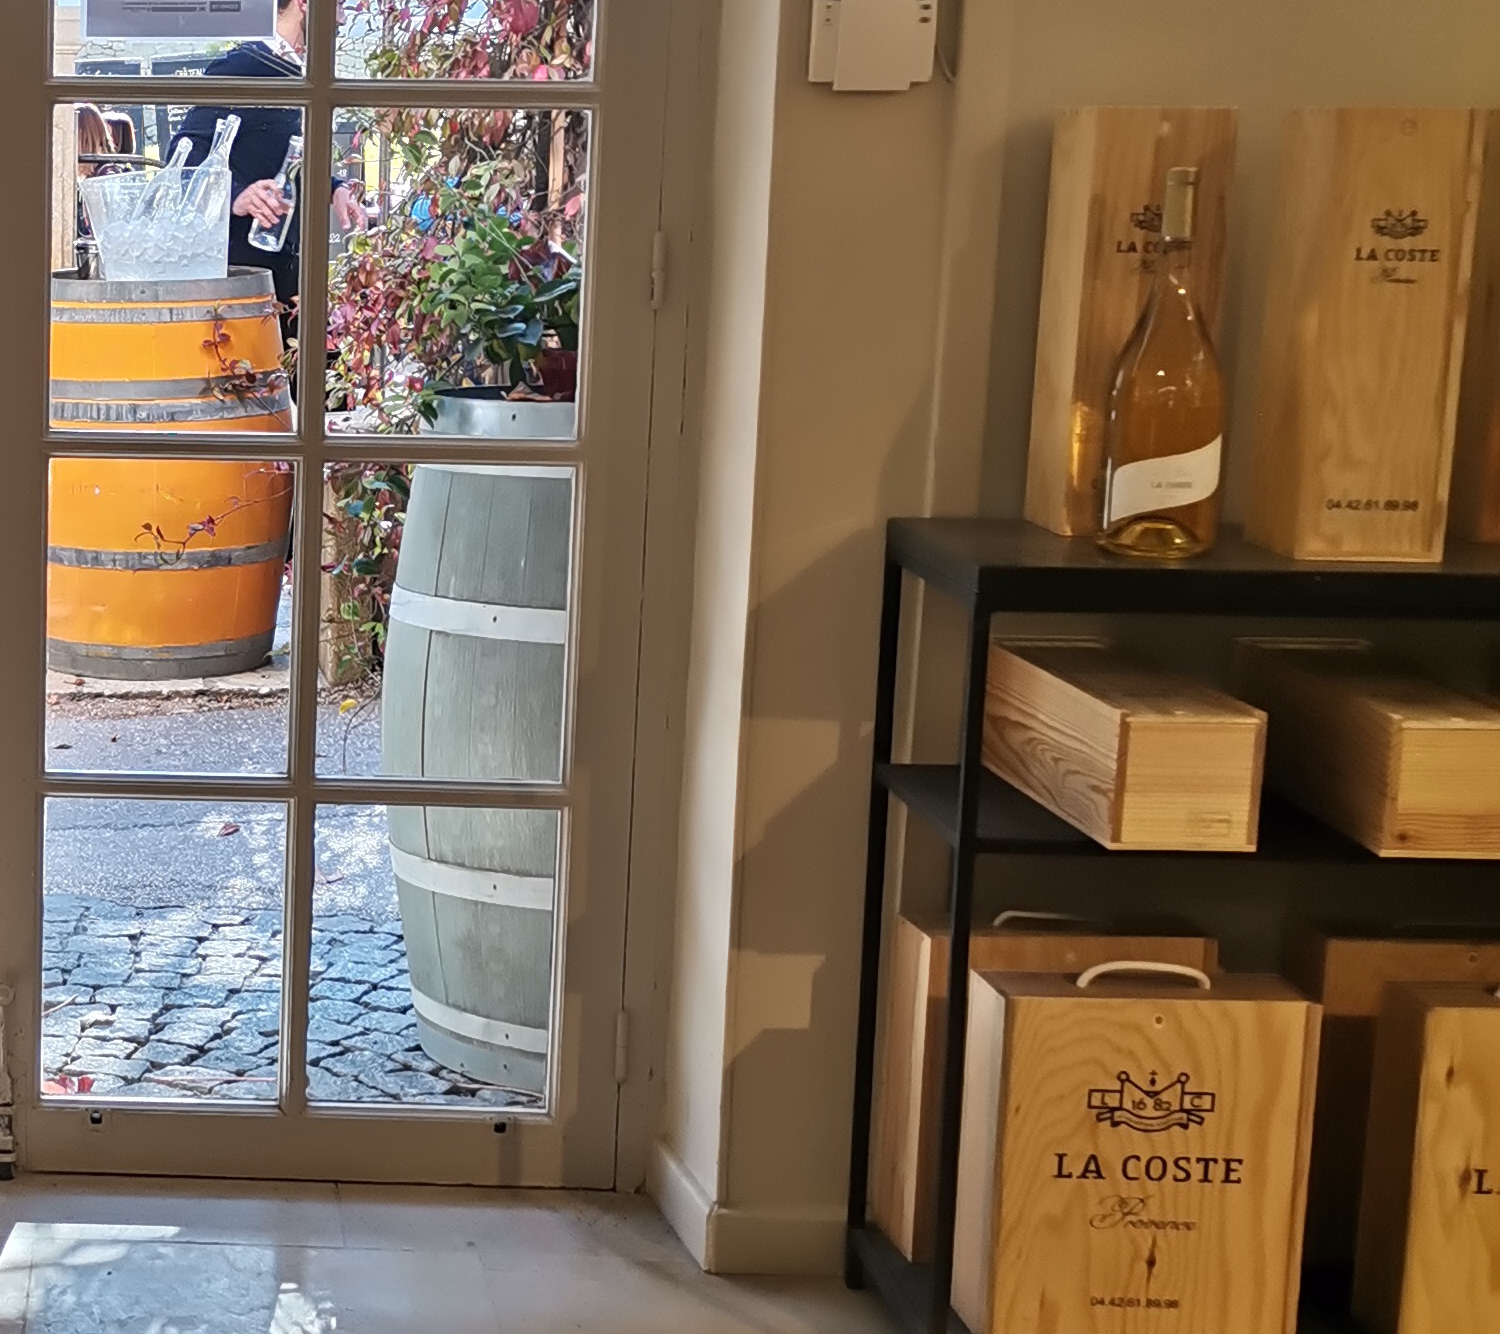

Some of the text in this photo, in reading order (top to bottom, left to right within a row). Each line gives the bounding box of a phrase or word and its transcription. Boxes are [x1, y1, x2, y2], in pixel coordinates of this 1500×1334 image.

[1115, 240, 1138, 254] LA
[1354, 247, 1441, 263] LA COSTE
[1052, 1152, 1244, 1185] LA COSTE
[1472, 1168, 1500, 1196] L
